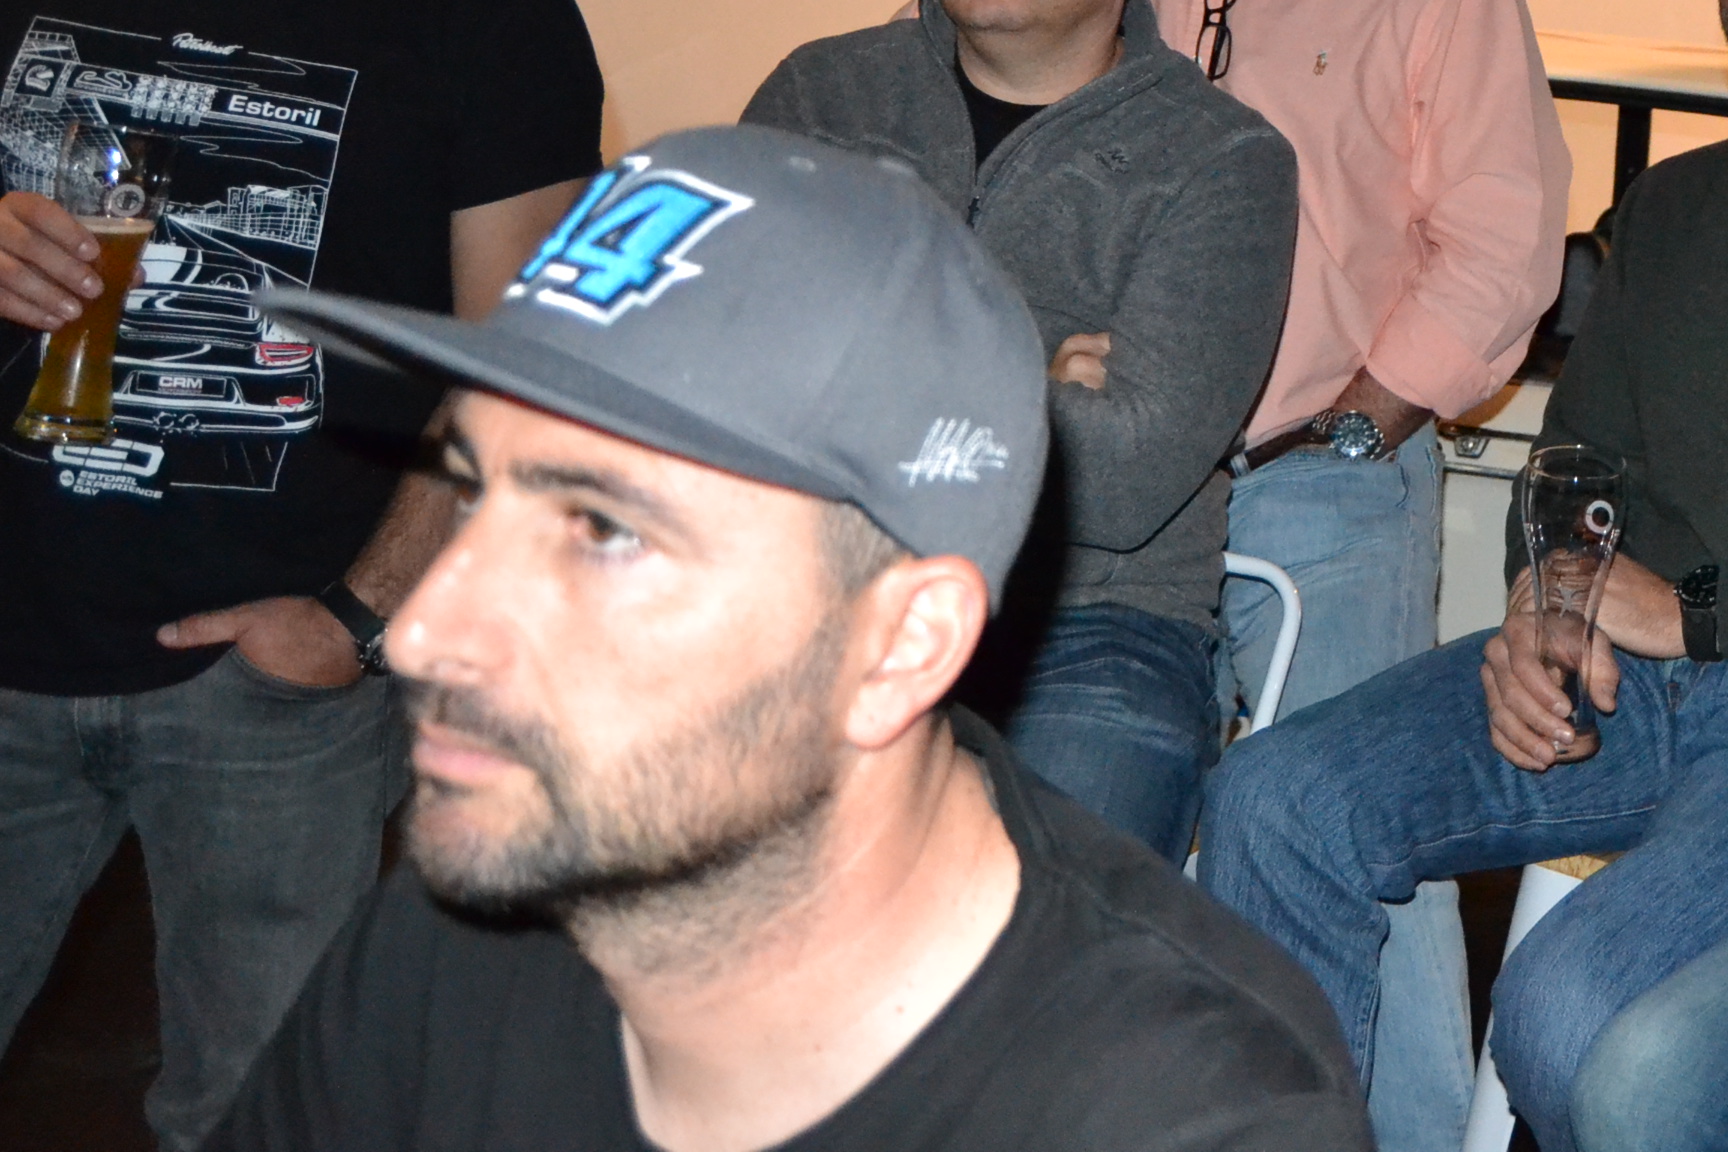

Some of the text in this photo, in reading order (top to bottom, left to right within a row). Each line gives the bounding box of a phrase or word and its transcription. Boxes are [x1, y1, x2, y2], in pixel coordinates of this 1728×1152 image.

[228, 94, 322, 126] Estoril
[159, 376, 203, 389] CRM
[79, 470, 138, 486] ESTORIL
[72, 485, 100, 496] DAY
[75, 477, 164, 499] EXPERIENCE
